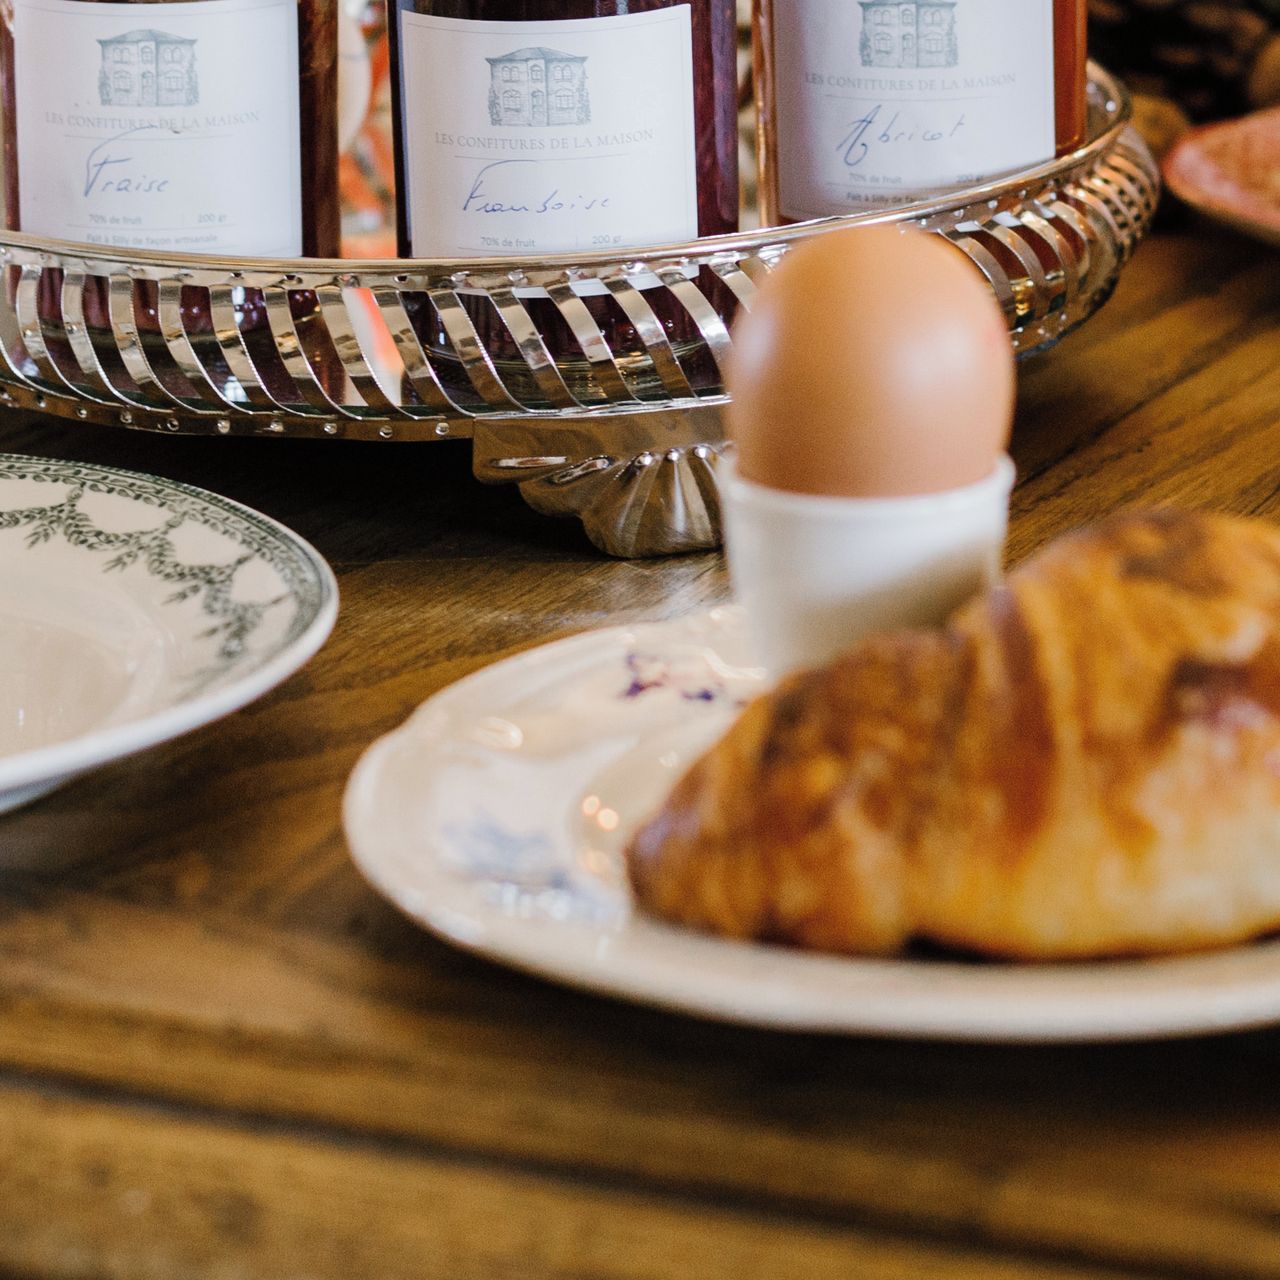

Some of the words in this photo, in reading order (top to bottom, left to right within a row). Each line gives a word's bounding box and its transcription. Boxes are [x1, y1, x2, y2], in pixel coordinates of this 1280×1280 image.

[805, 72, 824, 86] LES
[827, 75, 914, 91] CONFITURES
[918, 78, 937, 91] DE
[941, 78, 960, 90] LA
[963, 72, 1017, 89] MAISON
[45, 111, 64, 125] LES
[66, 115, 154, 130] CONFITURES
[160, 116, 178, 131] DE
[181, 116, 200, 129] LA
[206, 111, 260, 128] MAISON
[435, 132, 455, 145] LES
[456, 135, 546, 151] CONFITURES
[550, 137, 569, 150] DE
[574, 136, 593, 149] LA
[597, 128, 655, 147] MAISON
[835, 104, 966, 167] Abricot
[84, 124, 170, 198] Fraise
[480, 236, 499, 247] 70%
[501, 237, 513, 247] de
[515, 237, 536, 248] fruit
[592, 234, 610, 245] 200
